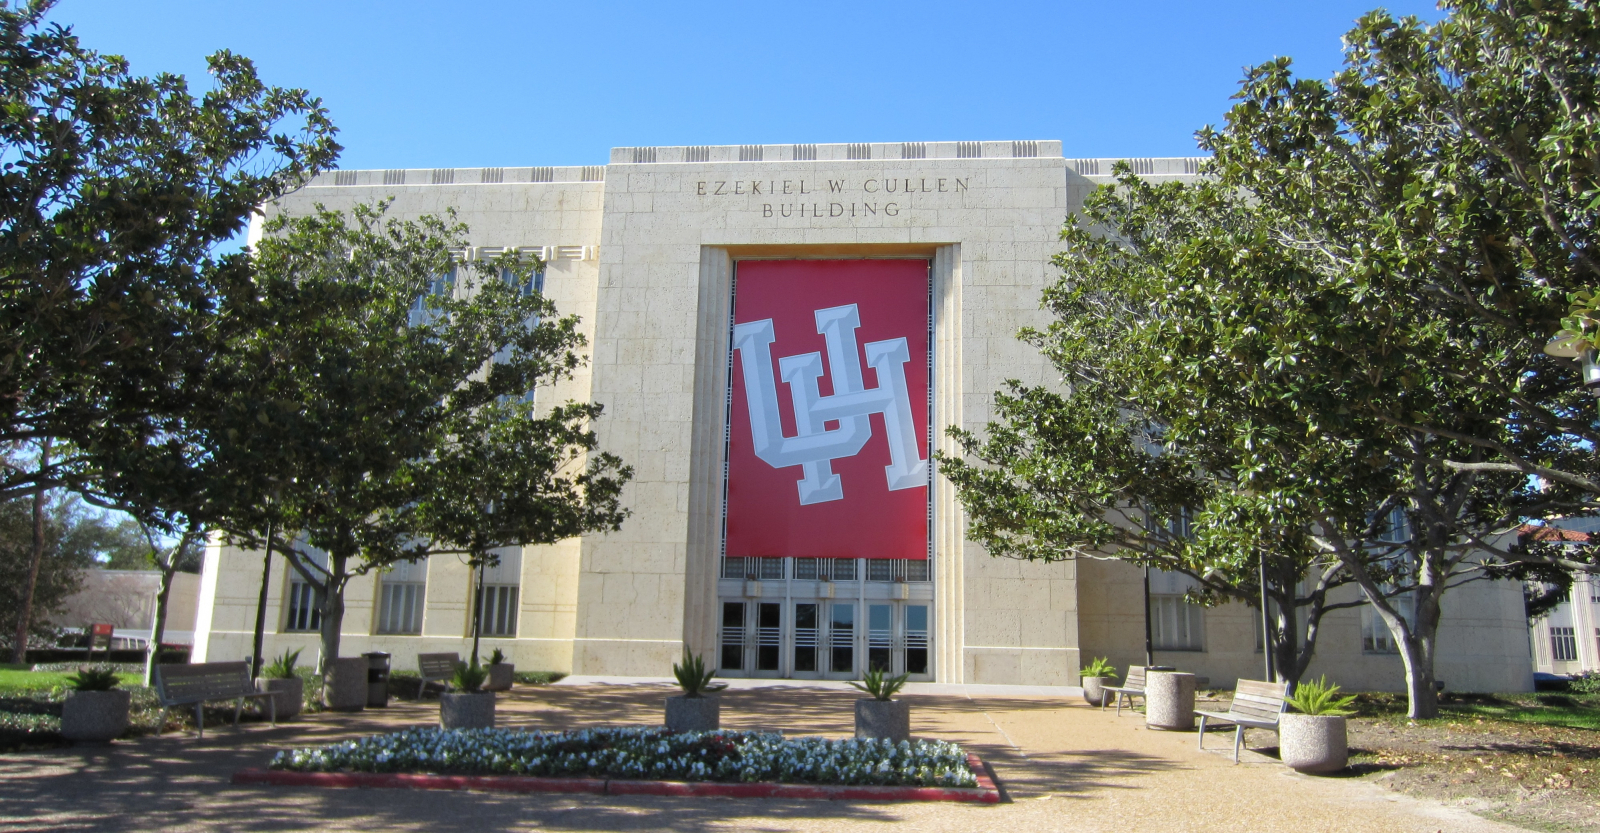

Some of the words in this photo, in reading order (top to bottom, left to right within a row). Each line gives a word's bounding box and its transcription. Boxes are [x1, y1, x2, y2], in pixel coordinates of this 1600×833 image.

[697, 179, 811, 195] EZEKIEL
[828, 179, 846, 193] W
[863, 177, 971, 193] CULLEN
[762, 202, 900, 218] BUILDING
[733, 303, 928, 506] UH
